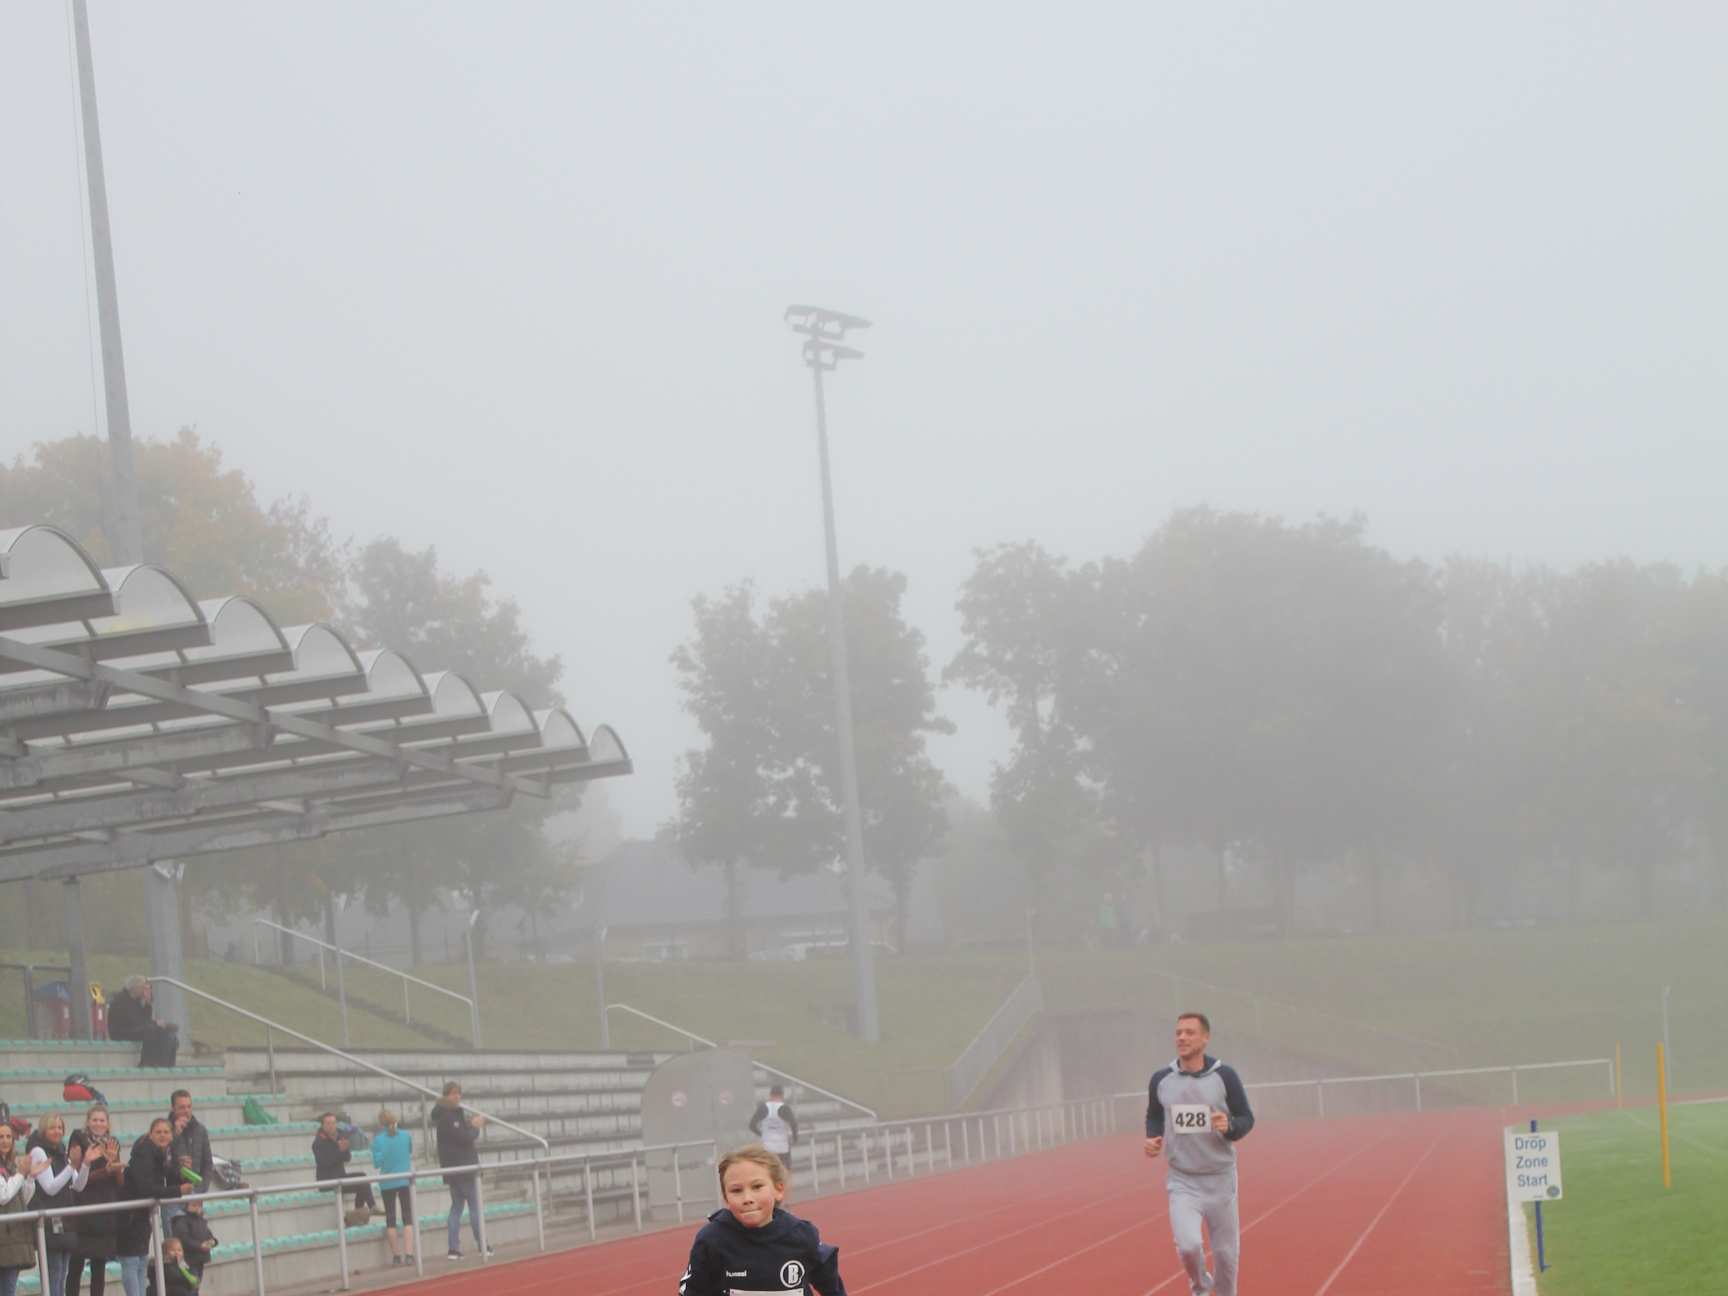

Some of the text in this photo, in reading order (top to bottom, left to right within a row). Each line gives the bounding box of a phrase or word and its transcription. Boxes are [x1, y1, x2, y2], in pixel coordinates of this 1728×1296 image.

[1175, 1112, 1206, 1128] 428
[1515, 1136, 1546, 1151] Drop
[1516, 1156, 1548, 1169] Zone
[1518, 1174, 1547, 1187] Start
